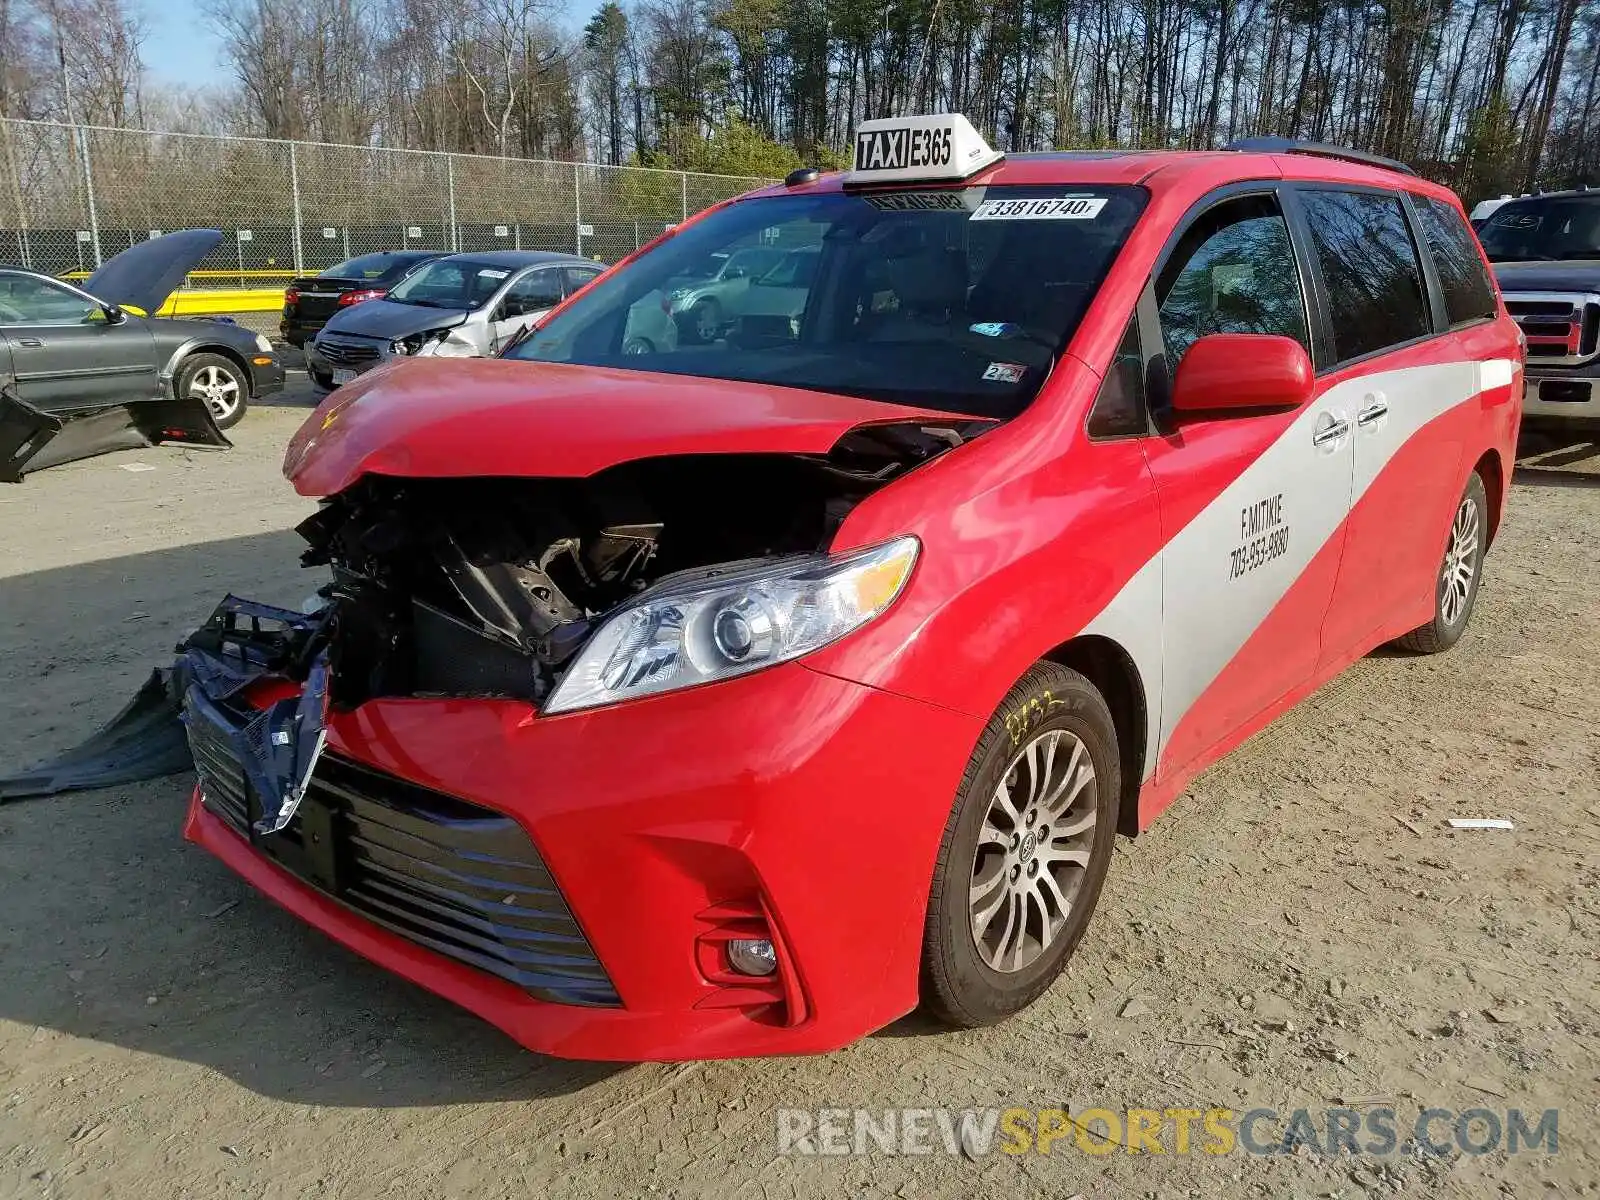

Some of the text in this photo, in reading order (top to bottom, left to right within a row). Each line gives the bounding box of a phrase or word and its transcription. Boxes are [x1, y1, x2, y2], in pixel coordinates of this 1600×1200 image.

[860, 127, 952, 169] TAXI E365
[988, 200, 1089, 216] 33816740
